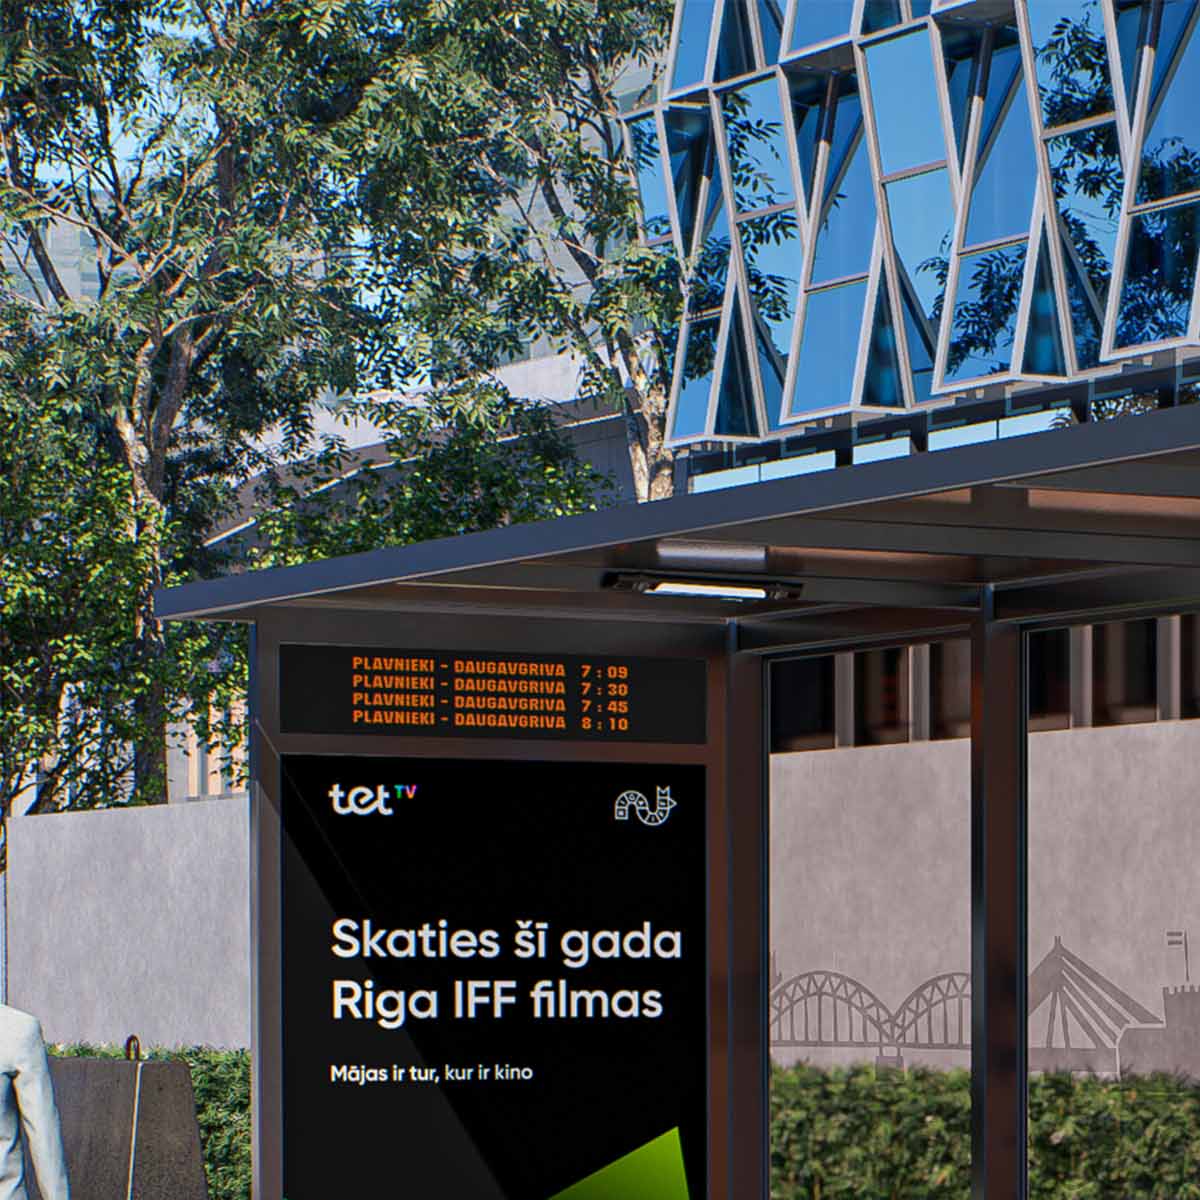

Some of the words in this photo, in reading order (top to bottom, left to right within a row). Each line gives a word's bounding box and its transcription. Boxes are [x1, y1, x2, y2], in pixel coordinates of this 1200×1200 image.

[353, 657, 434, 671] PLAVNIEKI
[454, 661, 565, 676] DAUGAVGRIVA
[353, 675, 434, 689] PLAVNIEKI
[454, 678, 564, 693] DAUGAVGRIVA
[353, 693, 434, 707] PLAVNIEKI
[455, 696, 565, 711] DAUGAVGRIVA
[353, 710, 434, 724] PLAVNIEKI
[455, 713, 565, 728] DAUGAVGRIVA
[329, 784, 393, 815] tet
[395, 785, 416, 798] TV
[332, 919, 500, 958] Skaties
[514, 920, 548, 958] šī
[561, 922, 681, 968] gada
[333, 980, 437, 1029] Riga
[455, 981, 516, 1018] IFF
[530, 980, 663, 1017] filmas
[331, 1065, 388, 1085] Mājas
[393, 1065, 405, 1081] ir
[409, 1066, 439, 1083] tur,
[445, 1065, 473, 1080] kur
[478, 1064, 490, 1079] ir
[495, 1064, 533, 1079] kino
